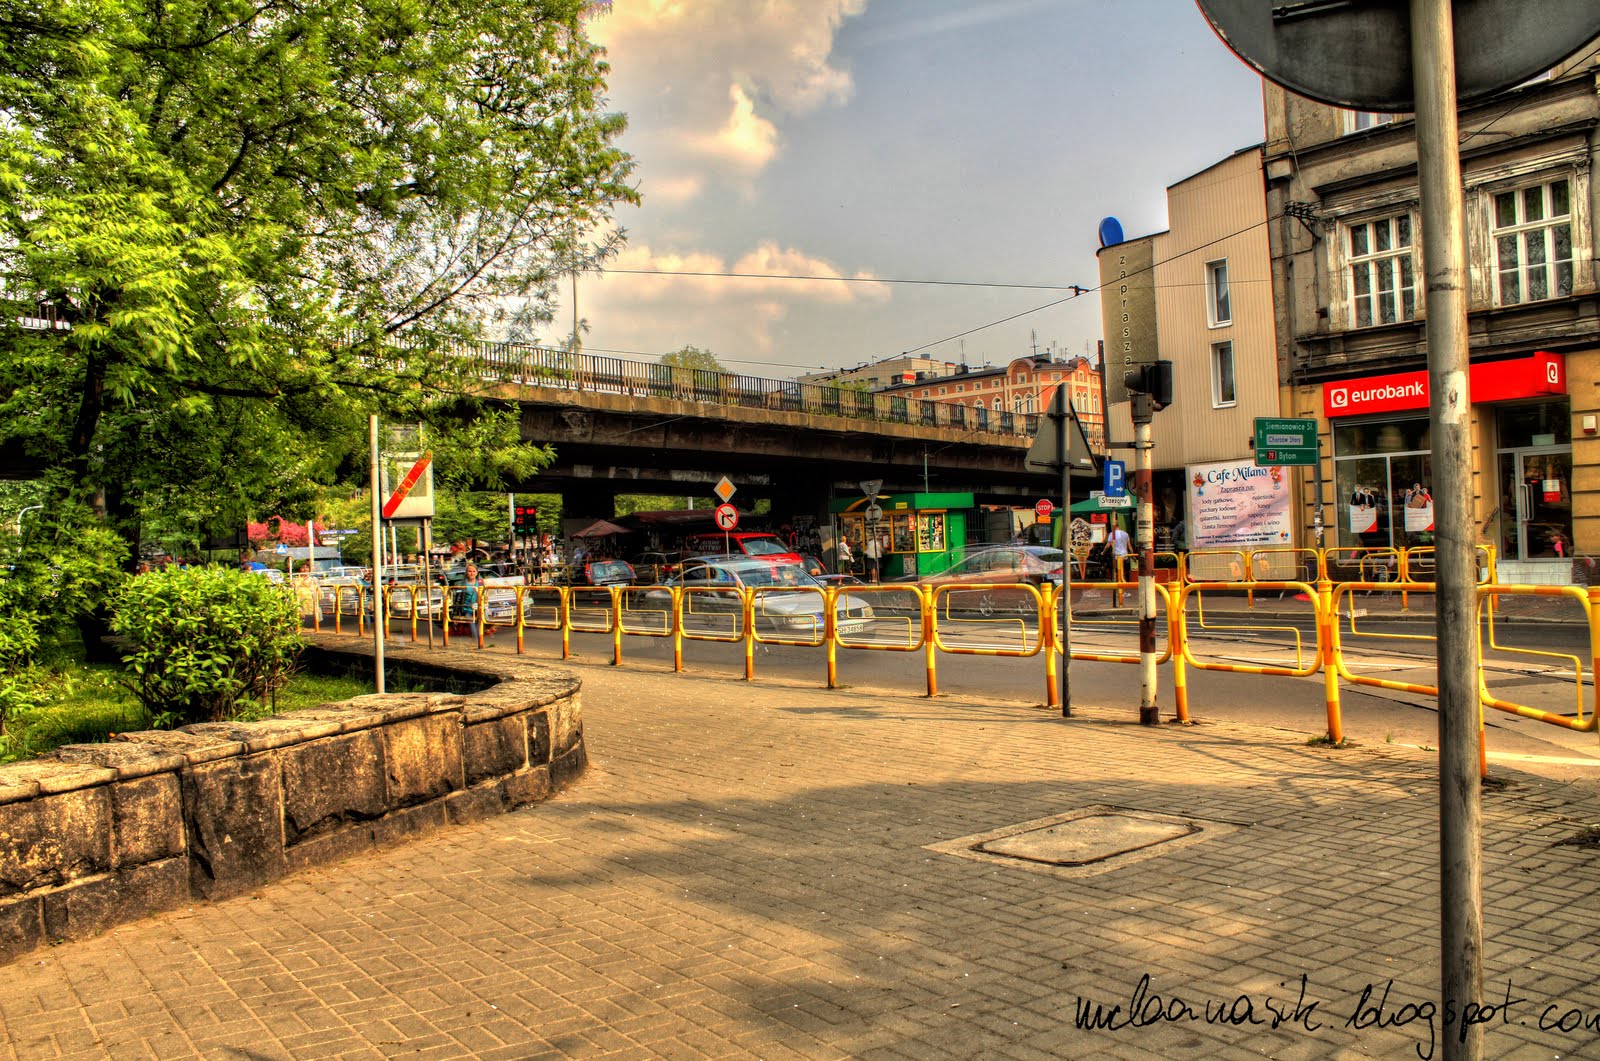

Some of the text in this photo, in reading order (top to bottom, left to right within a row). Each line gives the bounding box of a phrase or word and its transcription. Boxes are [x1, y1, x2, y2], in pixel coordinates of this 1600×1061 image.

[1351, 382, 1425, 403] eurobank
[1265, 421, 1305, 430] Siemianowice
[1289, 436, 1301, 444] Stary
[1278, 452, 1297, 461] Bytom
[1109, 464, 1122, 487] P
[1207, 467, 1268, 485] Cafe Milano
